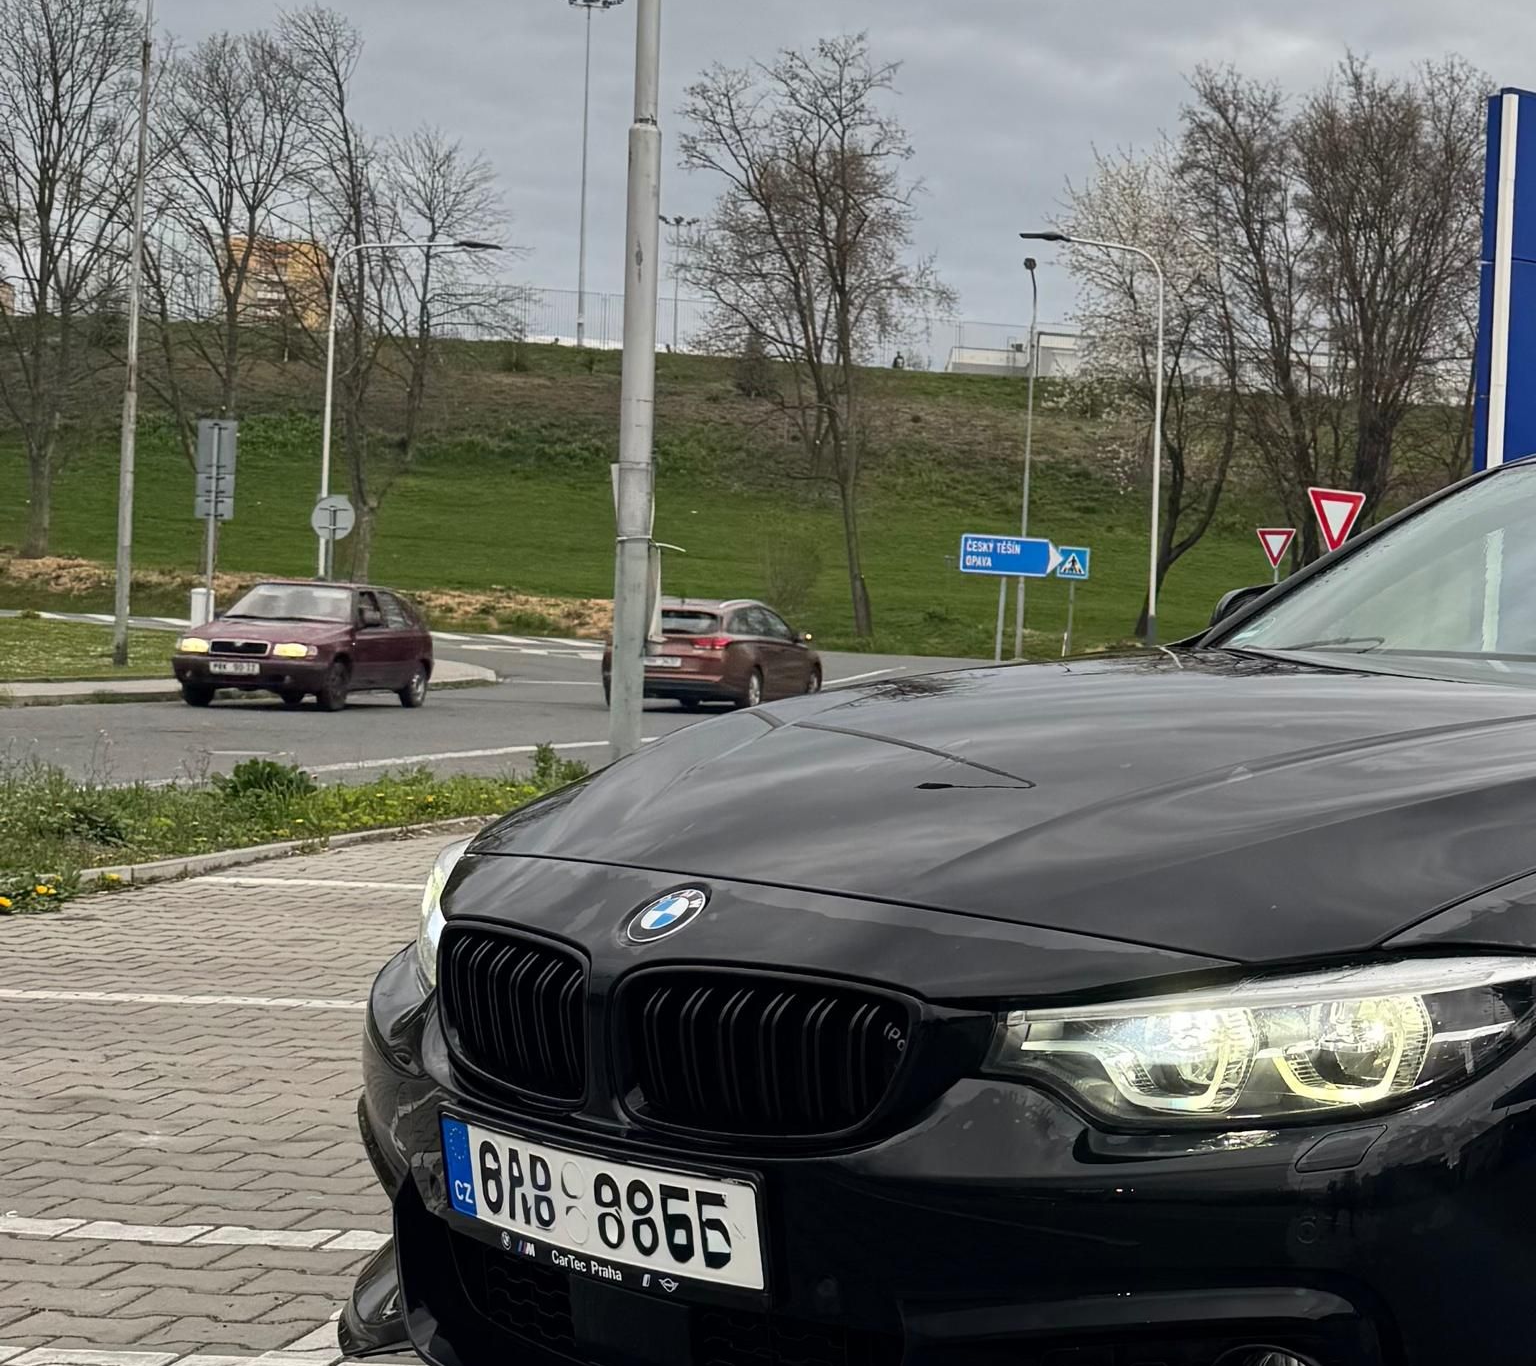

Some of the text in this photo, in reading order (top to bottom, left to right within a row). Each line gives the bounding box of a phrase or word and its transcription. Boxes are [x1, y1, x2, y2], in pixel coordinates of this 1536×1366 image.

[965, 555, 992, 567] OPAVA
[455, 1180, 473, 1204] CZ
[551, 1250, 622, 1282] CarTec Praha
